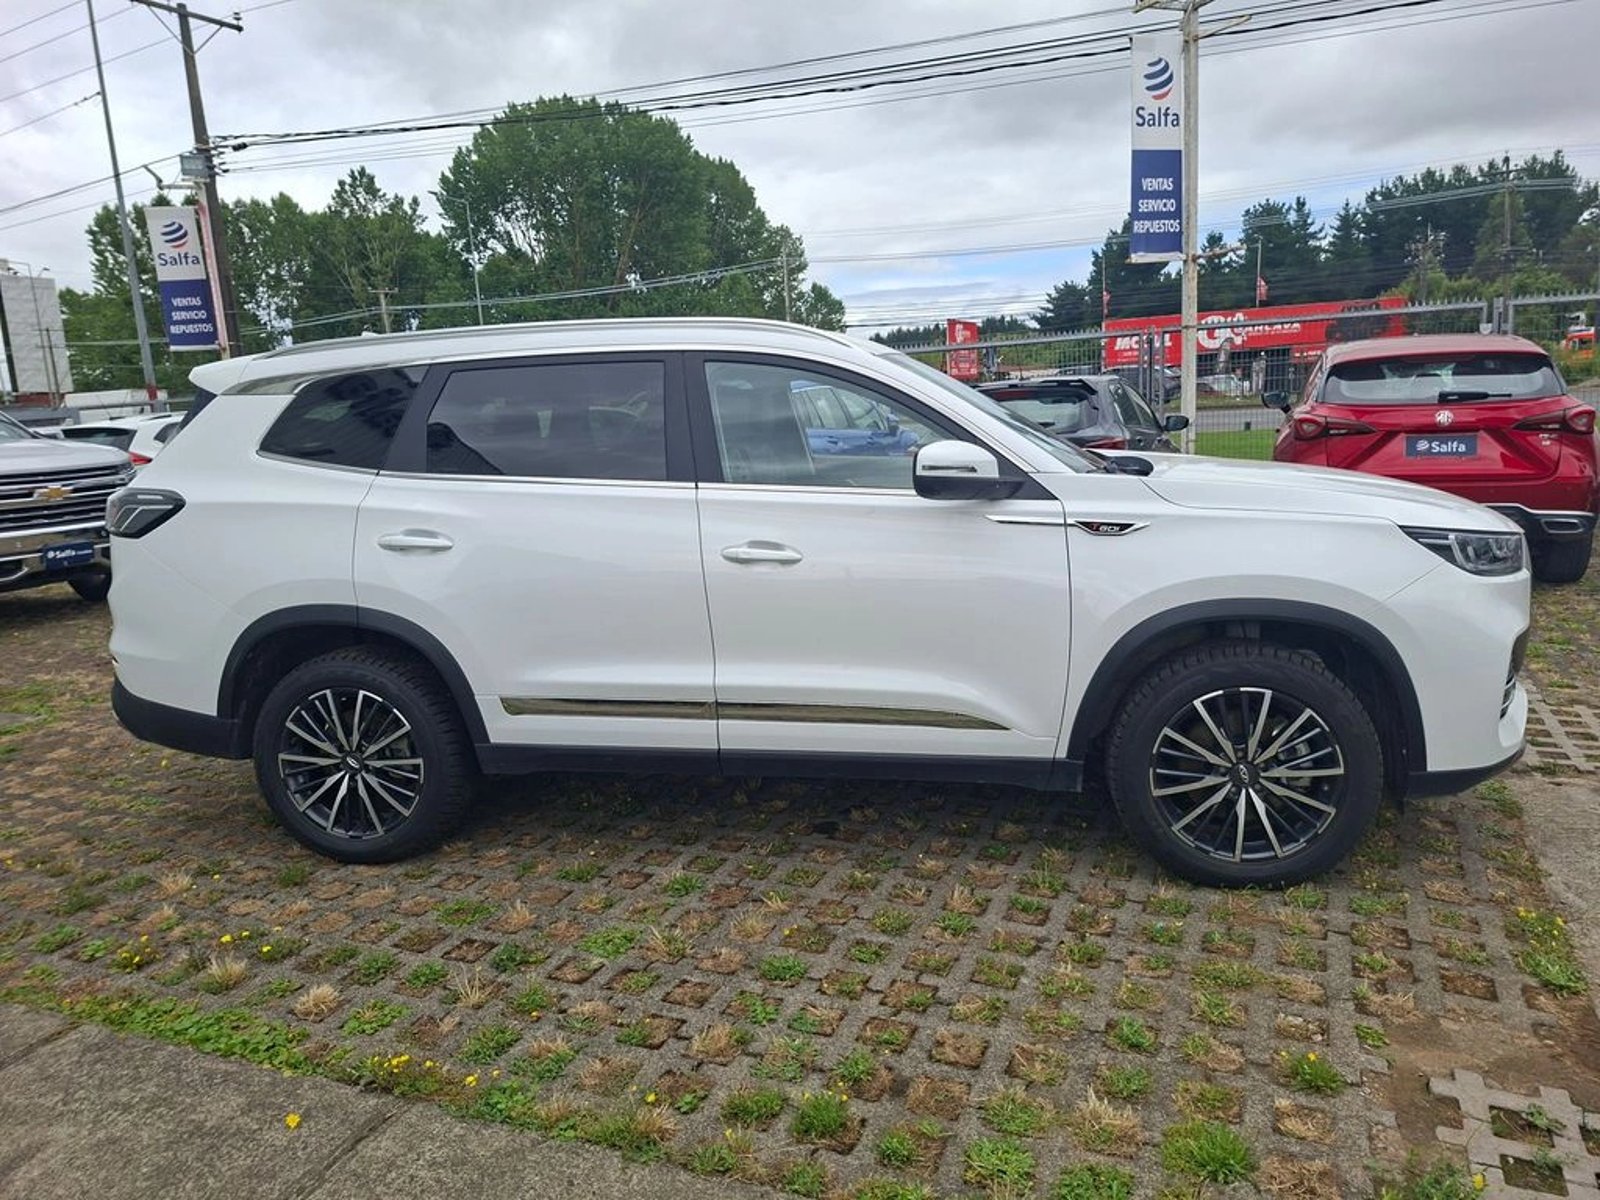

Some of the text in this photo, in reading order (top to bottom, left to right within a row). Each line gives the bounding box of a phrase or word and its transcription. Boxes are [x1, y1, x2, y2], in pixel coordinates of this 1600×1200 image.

[1135, 106, 1180, 128] Salfa
[1141, 177, 1174, 191] VENTAS
[1138, 198, 1176, 212] SERVICIO
[1133, 219, 1180, 234] REPUESTOS
[157, 252, 200, 267] Salfa
[171, 296, 202, 307] VENTAS
[171, 310, 207, 321] SERVICIO
[170, 323, 213, 334] REPUESTOS
[1430, 440, 1466, 453] Salfa
